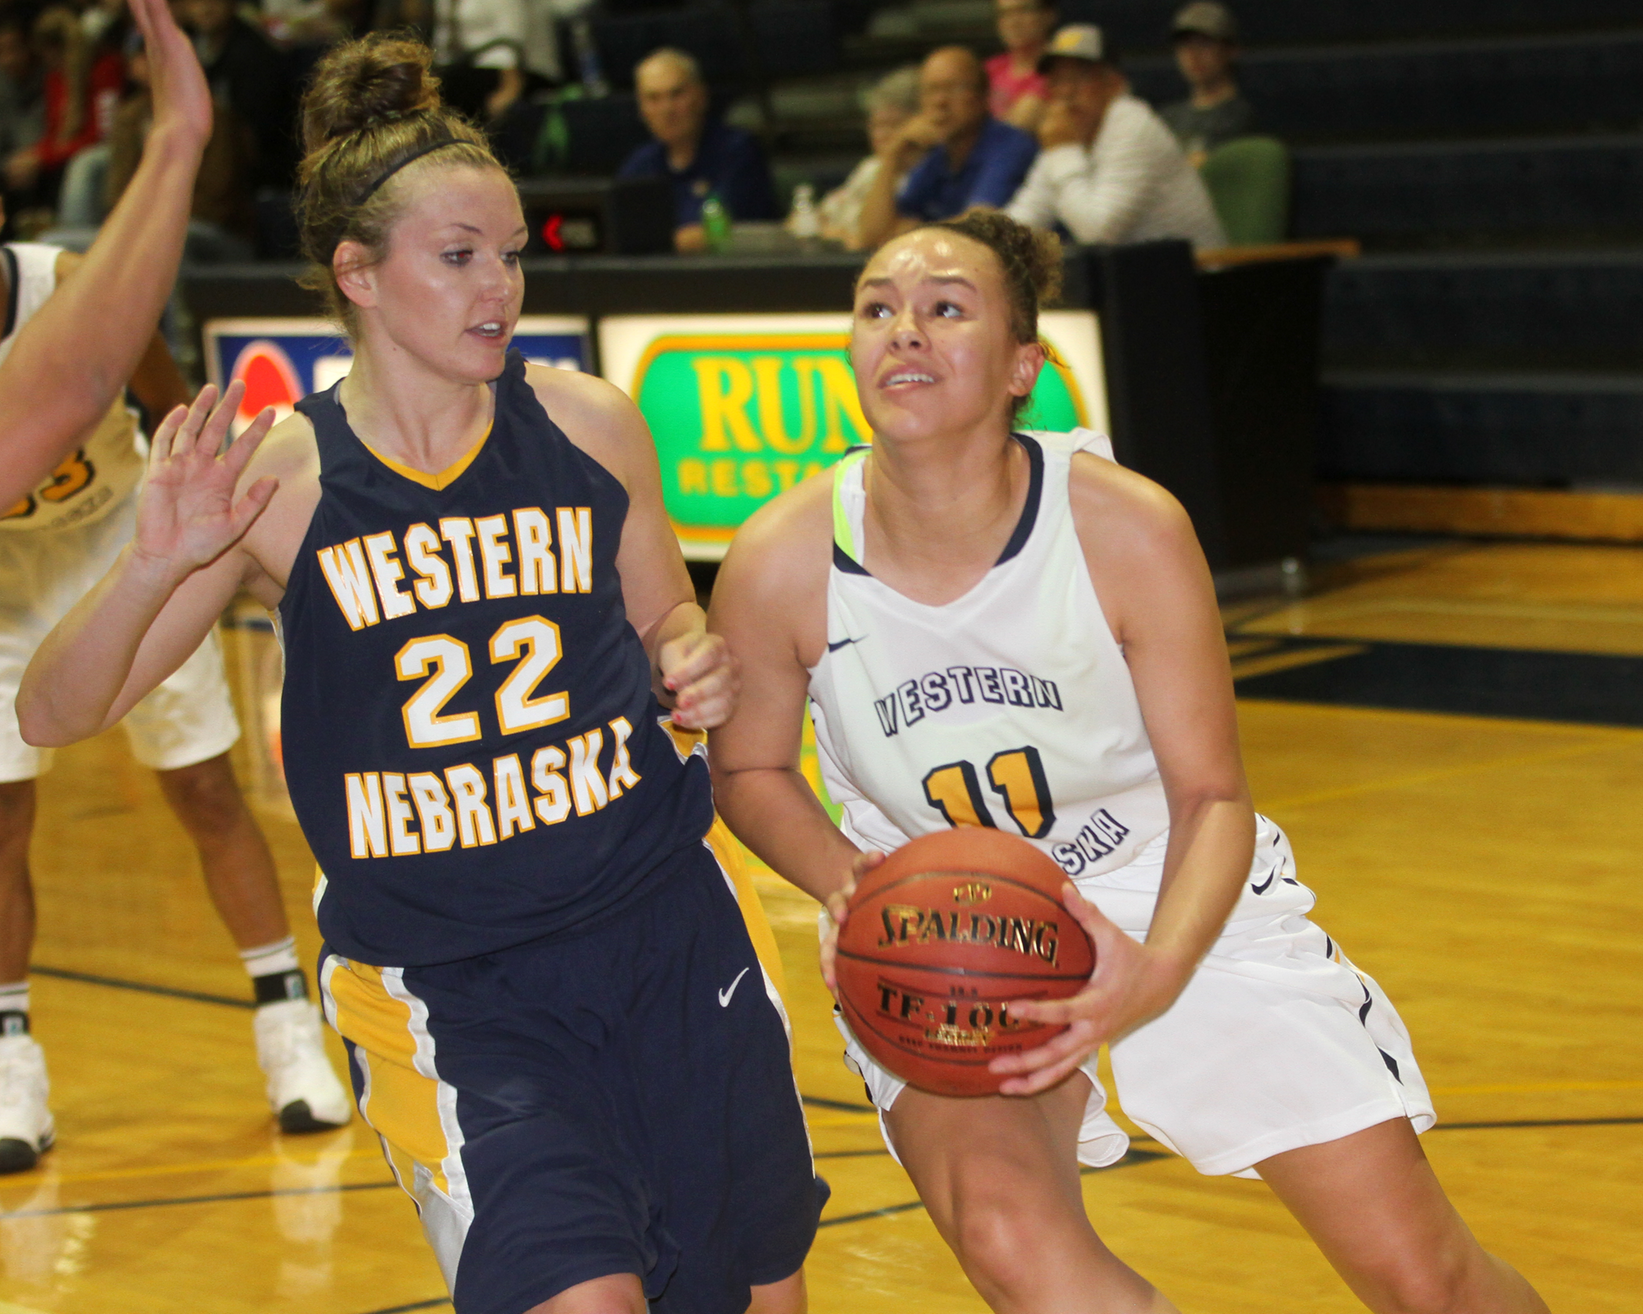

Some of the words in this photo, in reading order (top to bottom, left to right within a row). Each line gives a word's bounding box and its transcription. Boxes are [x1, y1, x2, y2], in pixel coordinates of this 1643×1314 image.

[316, 506, 593, 632] WESTERN
[394, 614, 571, 749] 22
[344, 716, 642, 859] NEBRASKA
[921, 745, 1057, 839] 11
[878, 904, 1060, 969] SPALDING
